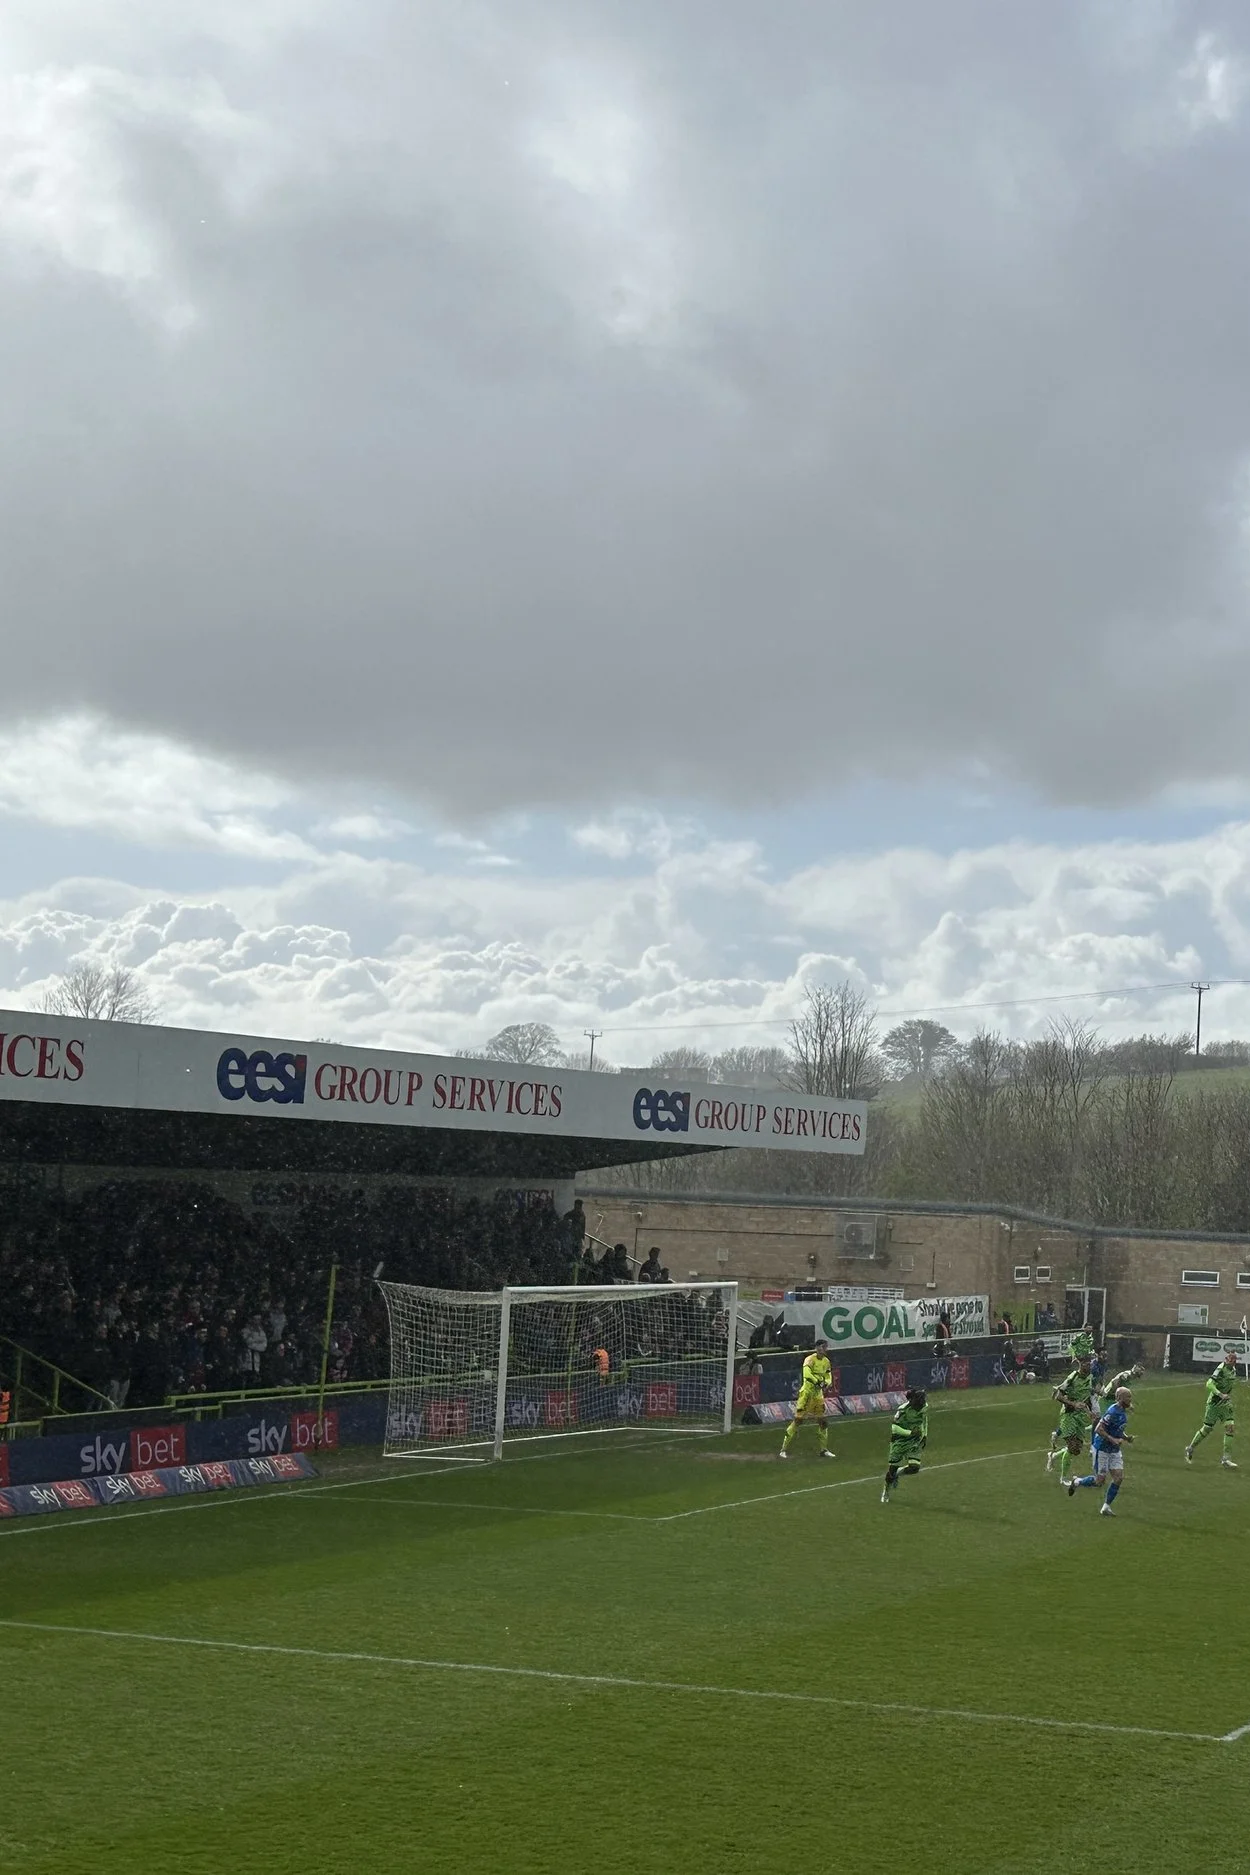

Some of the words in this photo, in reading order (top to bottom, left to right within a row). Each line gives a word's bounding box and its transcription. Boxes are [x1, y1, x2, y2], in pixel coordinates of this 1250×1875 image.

[314, 1063, 423, 1106] GROUP
[431, 1072, 562, 1118] SERVICES
[694, 1098, 766, 1133] GROUP
[771, 1107, 862, 1141] SERVICES
[822, 1305, 916, 1342] GOAL
[867, 1367, 885, 1392] sky
[887, 1366, 906, 1387] bet
[930, 1362, 949, 1387] sky
[649, 1384, 676, 1412] bet
[736, 1382, 759, 1404] bet
[247, 1419, 288, 1455] sky
[80, 1435, 126, 1474] sky
[137, 1433, 180, 1466] bet
[248, 1457, 275, 1477] sky
[272, 1455, 299, 1472] bet
[106, 1475, 135, 1496] sky
[132, 1472, 161, 1490] bet
[179, 1465, 206, 1485] sky
[204, 1463, 230, 1480] bet
[30, 1484, 62, 1508] sky
[56, 1484, 91, 1501] bet
